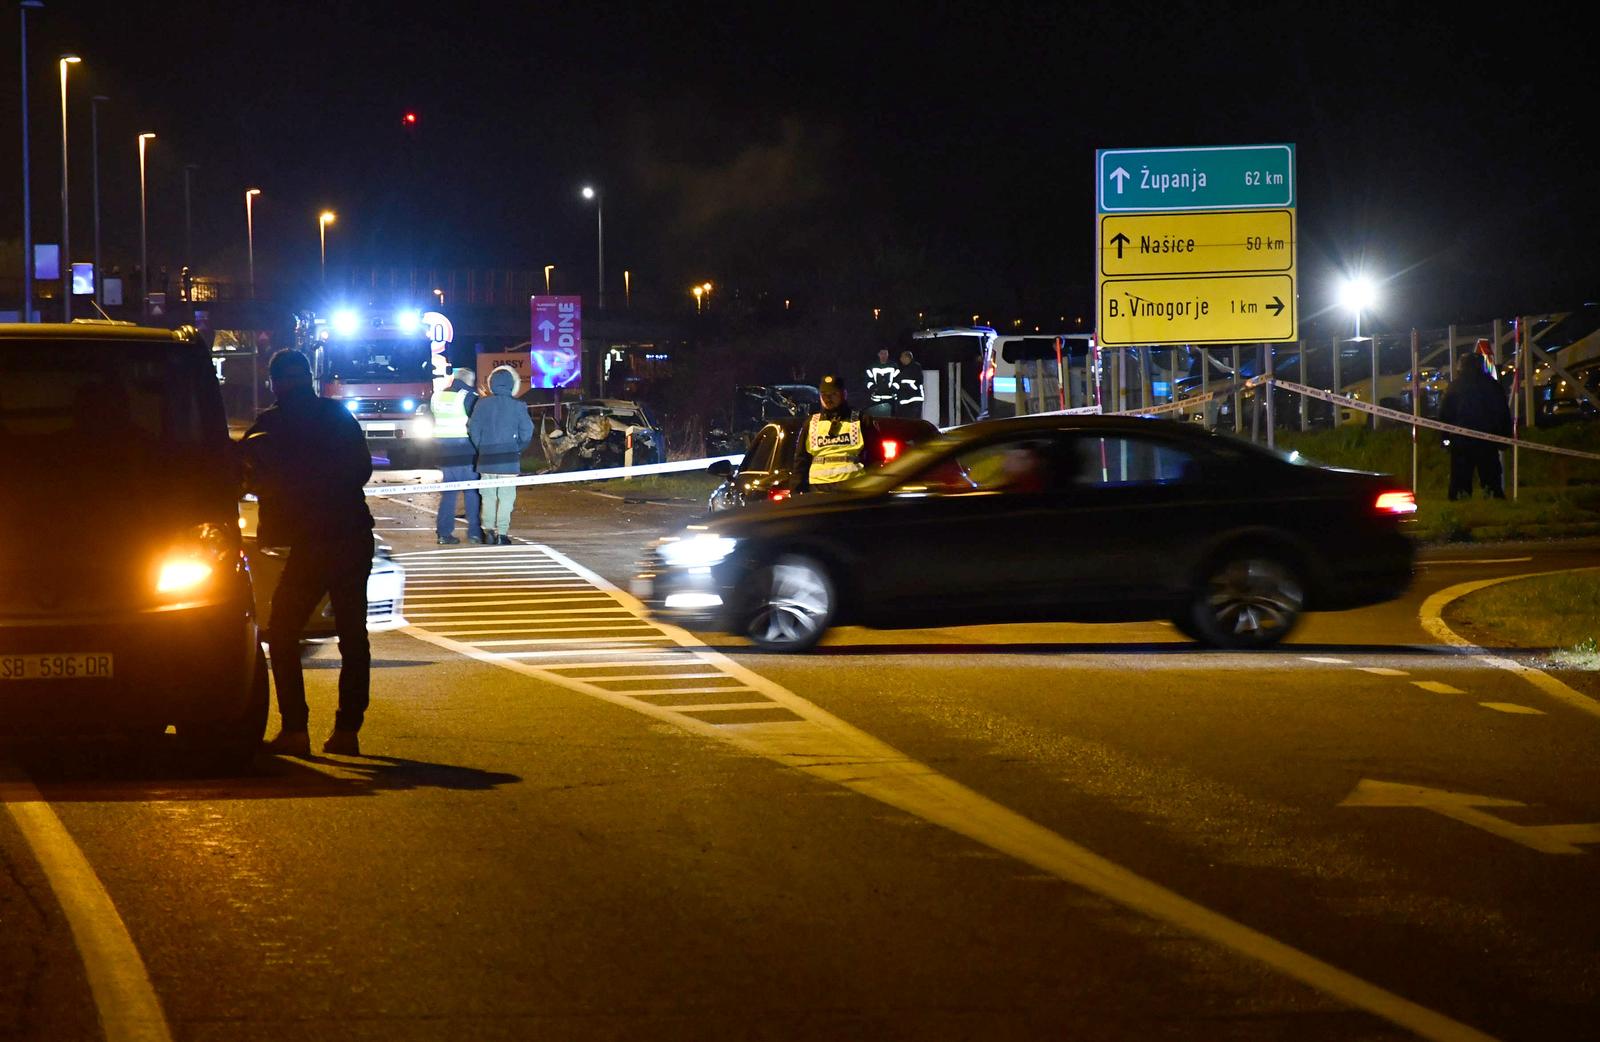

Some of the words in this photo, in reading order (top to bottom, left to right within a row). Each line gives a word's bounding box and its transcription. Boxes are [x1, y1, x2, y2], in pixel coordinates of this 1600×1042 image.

[1140, 165, 1207, 193] Županja
[1245, 171, 1261, 186] 62
[1266, 171, 1284, 185] km
[1140, 235, 1195, 254] Našice
[1246, 236, 1262, 250] 50
[1267, 236, 1284, 250] km
[1109, 299, 1125, 317] B.
[1129, 296, 1209, 321] Vinogorje
[1231, 301, 1235, 314] 1
[1240, 300, 1258, 314] km
[2, 658, 24, 677] SB
